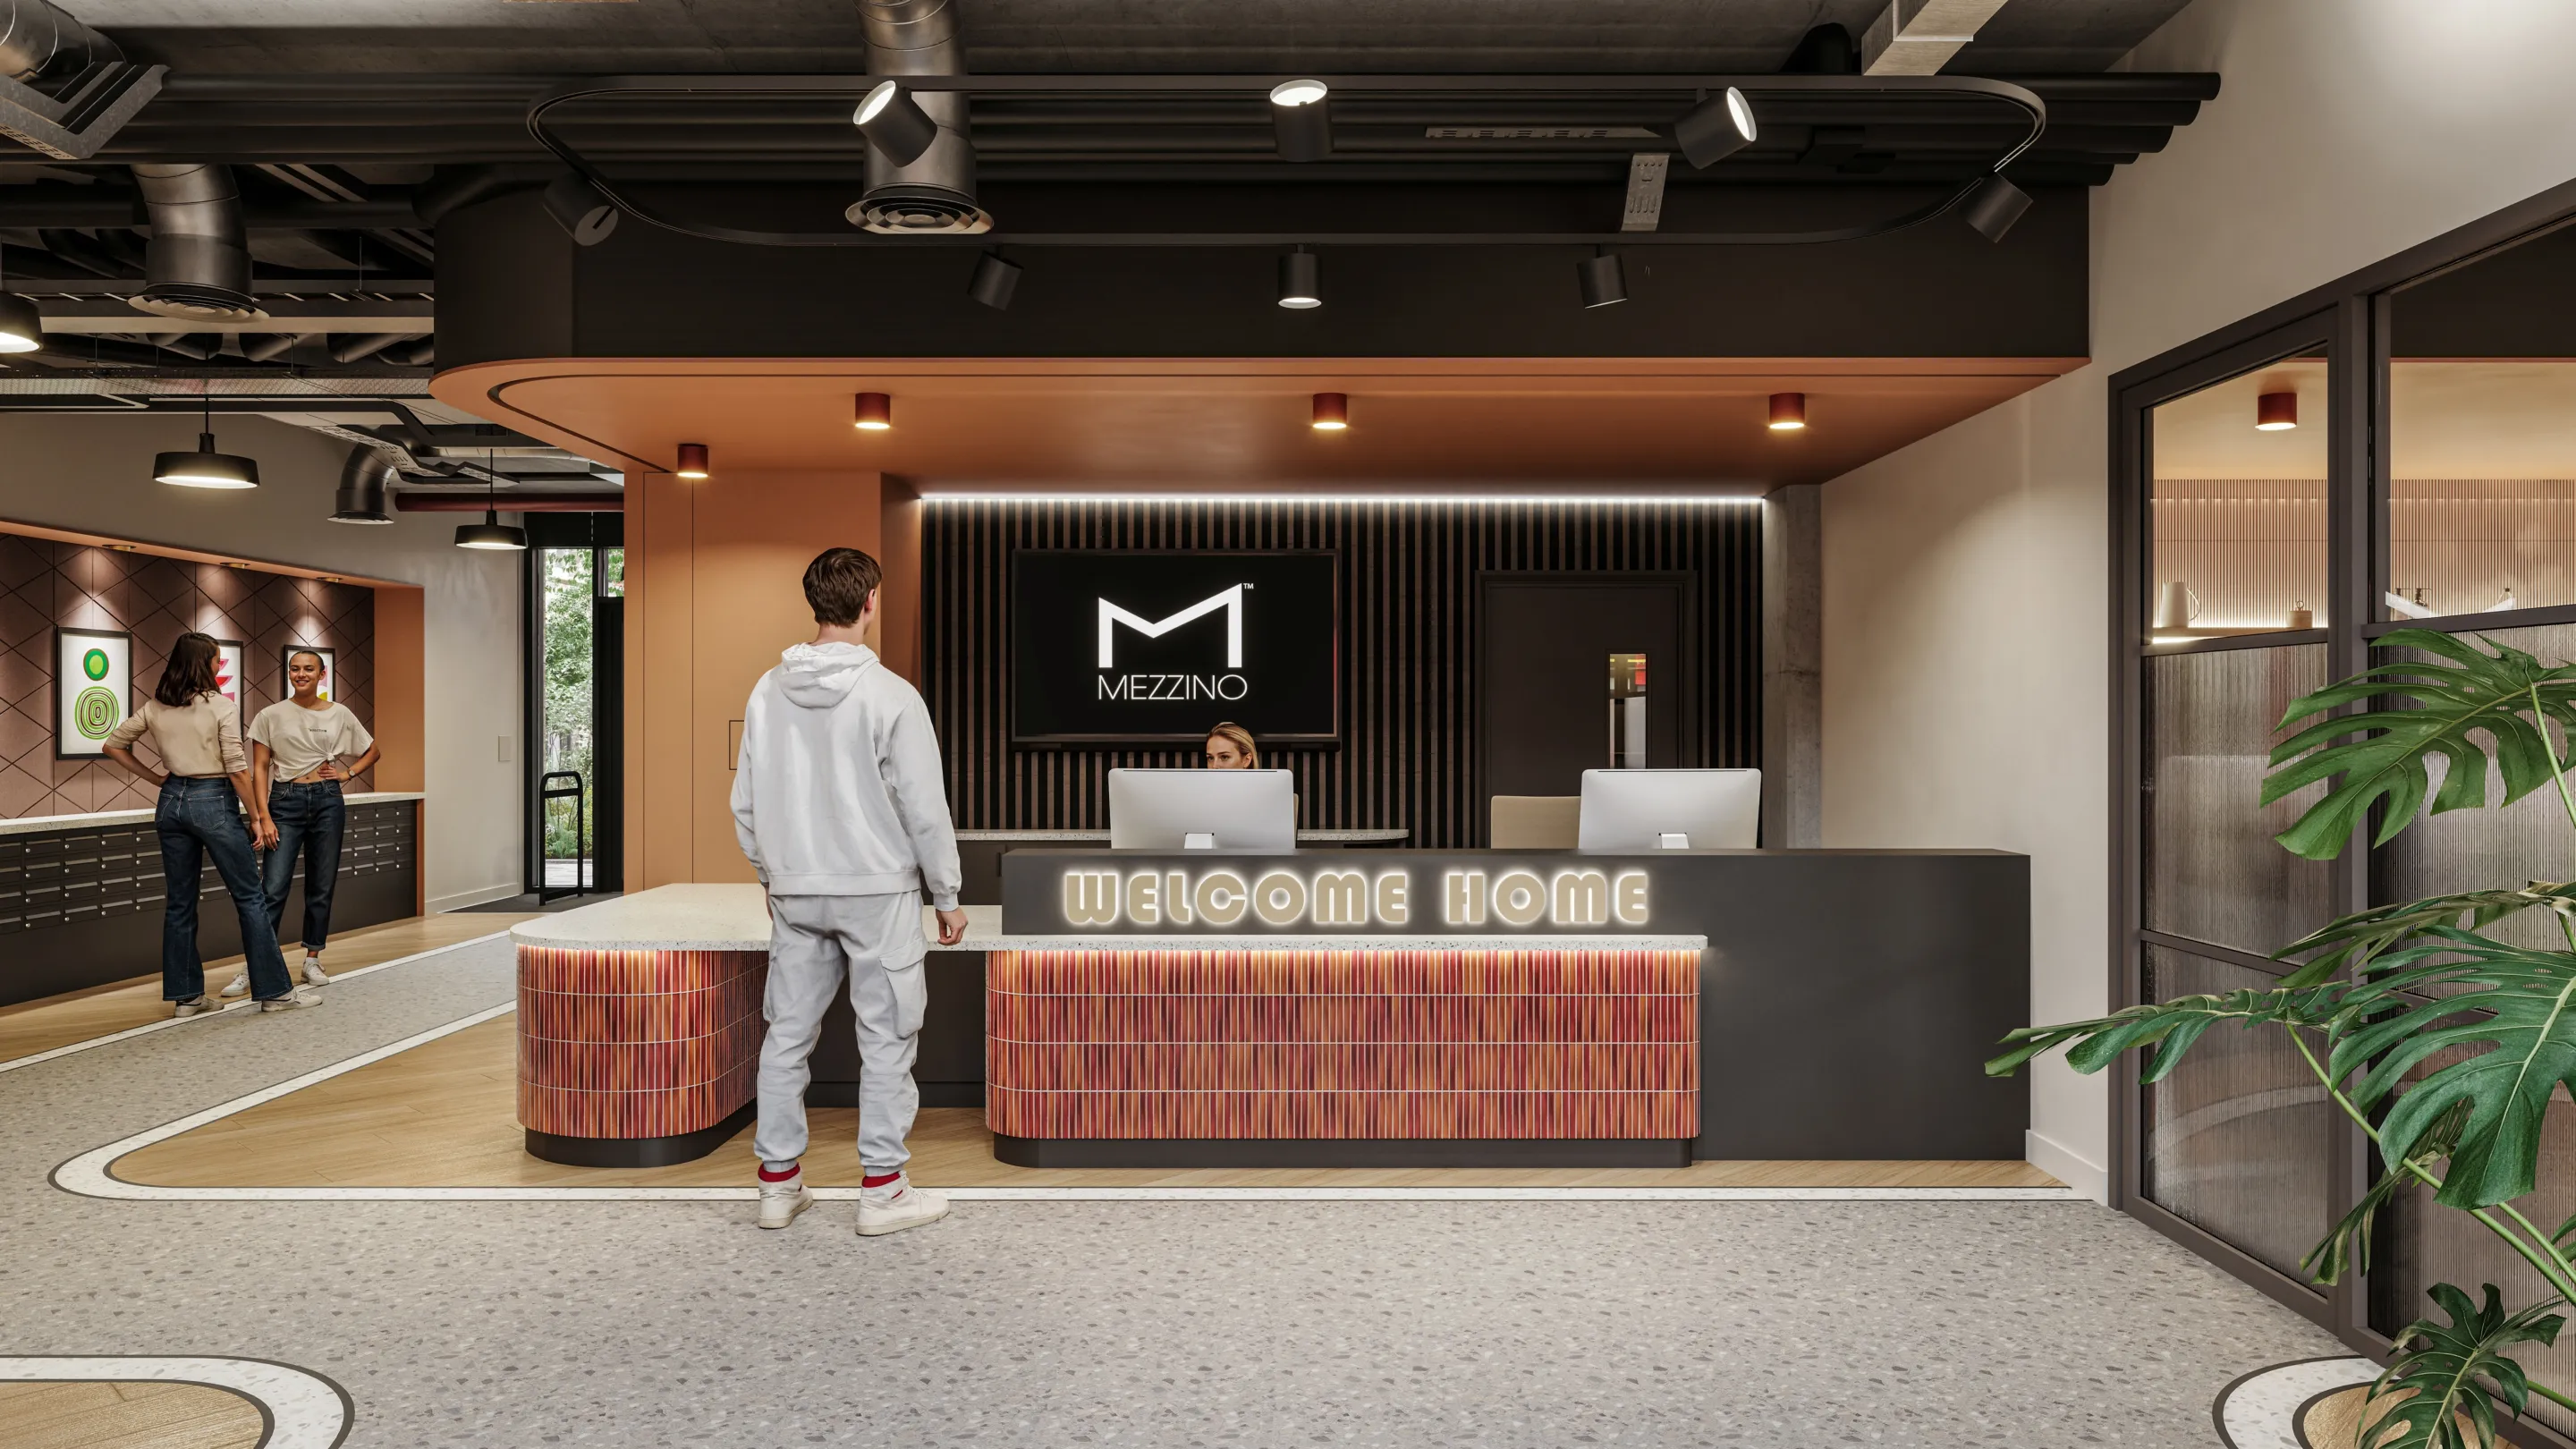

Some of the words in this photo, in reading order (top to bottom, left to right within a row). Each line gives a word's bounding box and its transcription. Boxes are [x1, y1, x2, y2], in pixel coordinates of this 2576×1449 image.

[1098, 674, 1249, 700] MEZZINO
[1064, 872, 1408, 925] WELCOME
[1445, 872, 1649, 925] HOME
